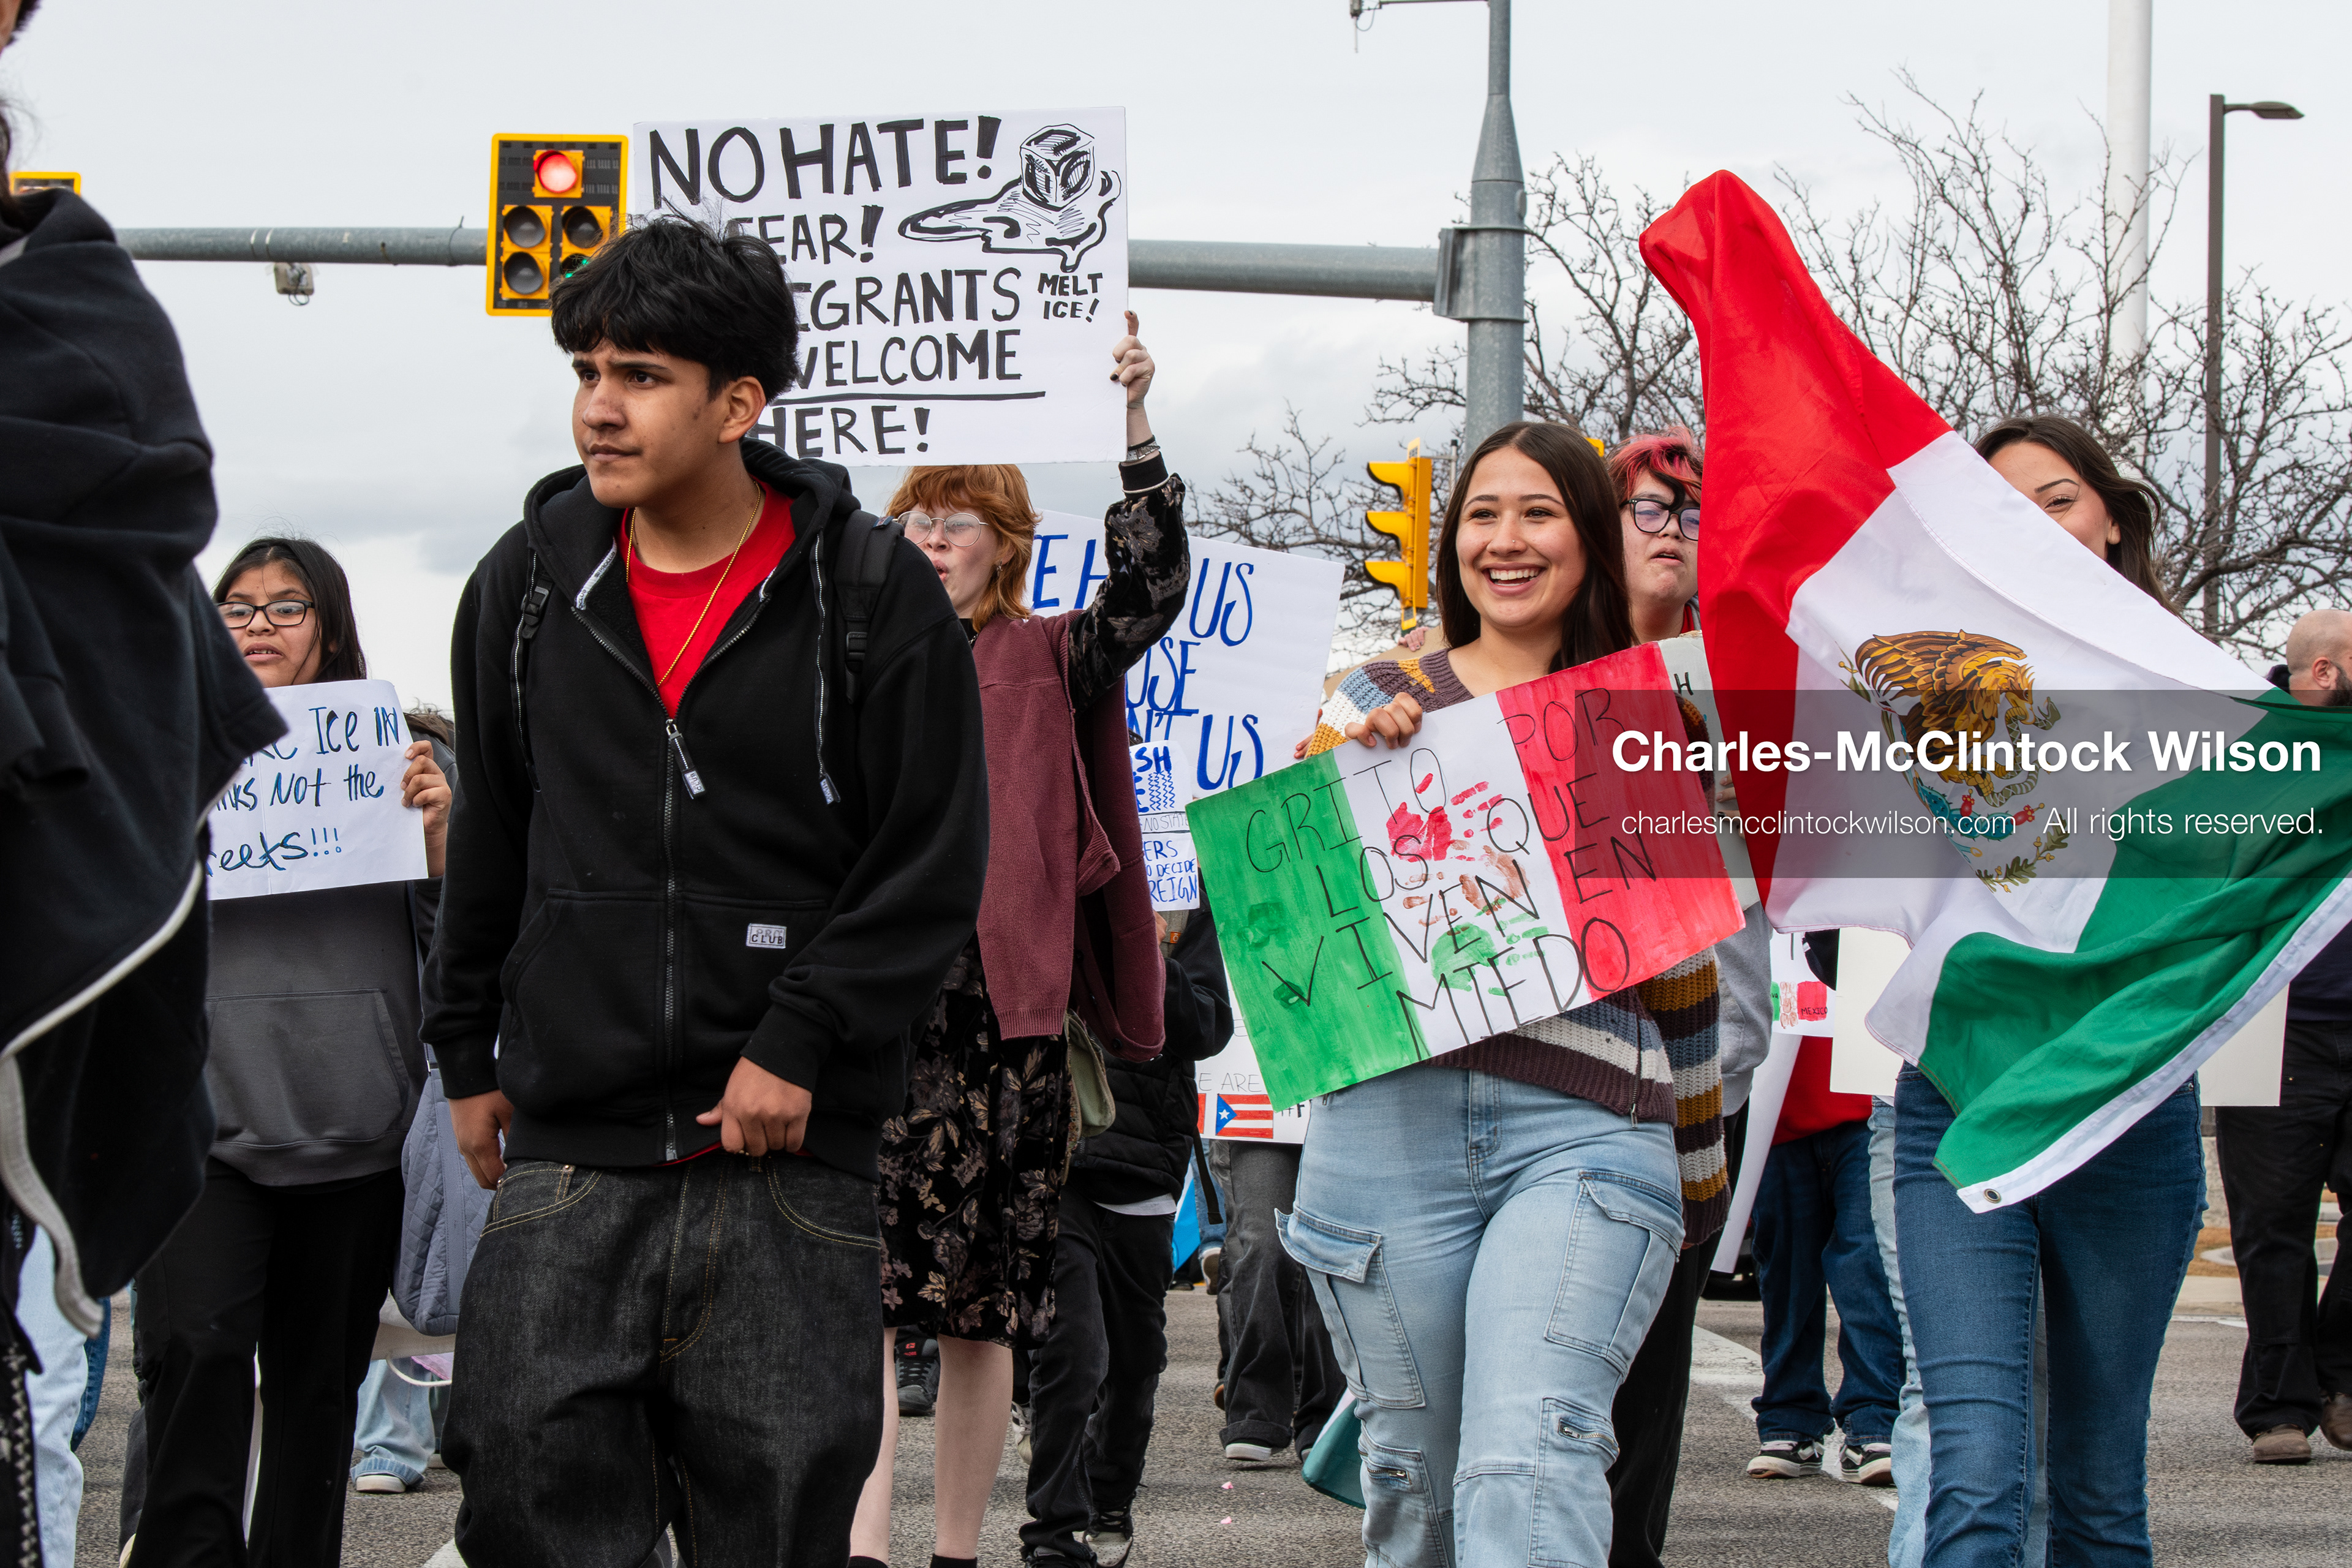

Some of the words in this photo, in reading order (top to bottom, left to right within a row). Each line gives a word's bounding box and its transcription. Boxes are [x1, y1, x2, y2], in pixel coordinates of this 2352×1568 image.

[649, 126, 765, 209] NO
[779, 116, 1002, 200] HATE!
[728, 205, 884, 264] EAR!
[788, 267, 1021, 331] GRANTS
[1038, 272, 1103, 296] MELT
[1044, 299, 1099, 322] ICE!
[1189, 558, 1254, 647] US
[1125, 636, 1201, 712] USE
[1134, 746, 1172, 773] SH
[1197, 714, 1264, 790] US
[1246, 748, 1449, 873] GRITO
[1496, 688, 1627, 773] POR
[206, 827, 342, 876] eets!!!
[1144, 840, 1178, 861] ERS
[1156, 858, 1196, 877] DECIDE
[1316, 835, 1428, 918] LOS
[1487, 773, 1610, 855] QUE
[1148, 875, 1197, 903] REIGN
[752, 934, 783, 944] CLUB
[1262, 859, 1540, 1006] VIVEN
[1563, 828, 1656, 903] EN
[1396, 917, 1630, 1061] MIEDO
[1801, 1007, 1828, 1016] MEXICO
[1221, 1072, 1262, 1093] ARE
